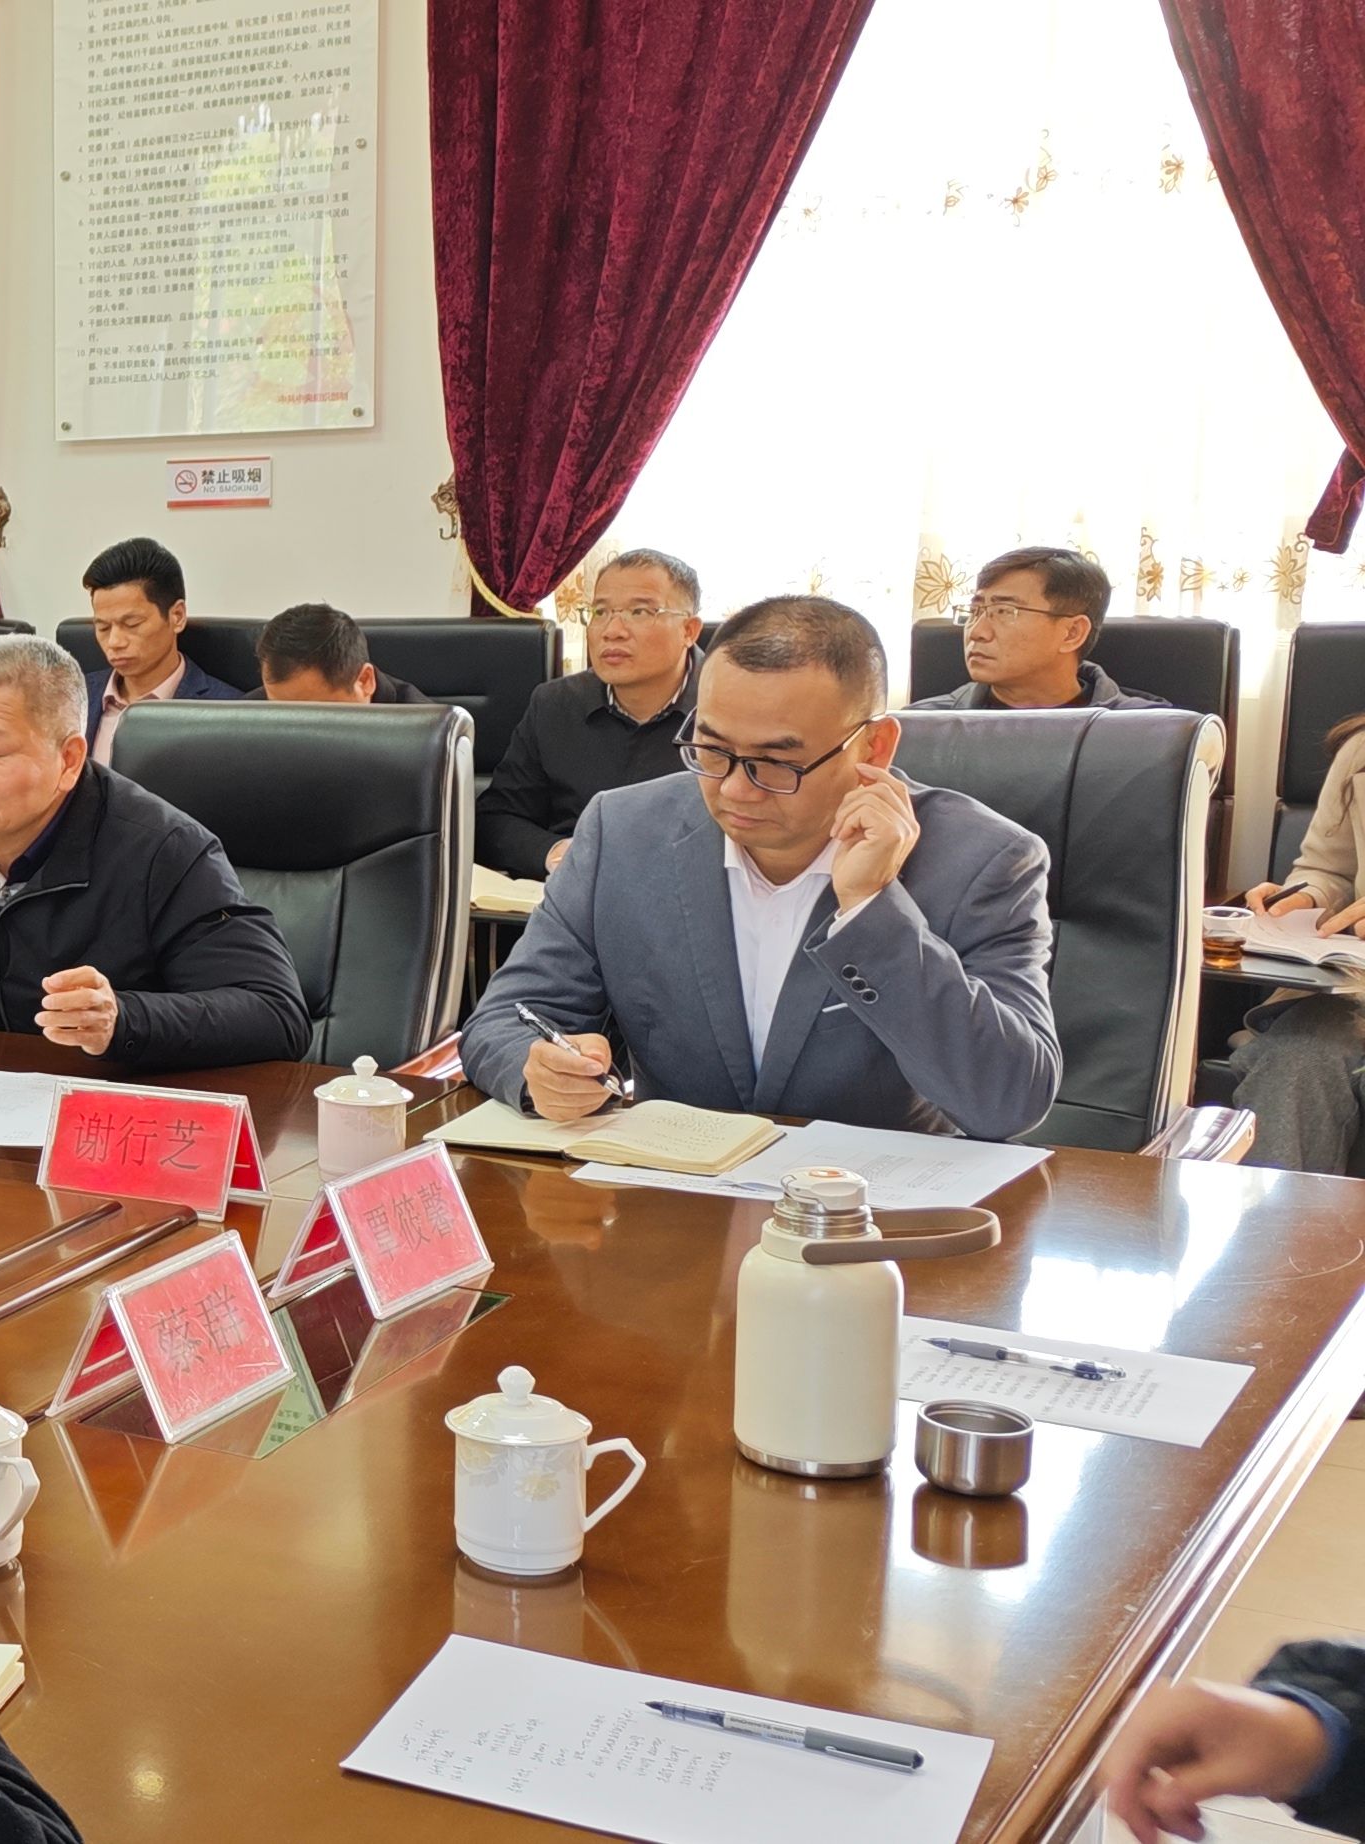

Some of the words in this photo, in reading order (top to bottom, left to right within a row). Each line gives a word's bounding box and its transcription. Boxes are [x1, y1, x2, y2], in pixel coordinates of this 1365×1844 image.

[200, 467, 263, 485] 禁止吸烟
[203, 485, 216, 494] NO
[219, 484, 259, 493] SMOKING
[72, 1111, 207, 1172] 谢行芝
[363, 1178, 456, 1261] 覃筱馨
[148, 1283, 246, 1378] 蔡群
